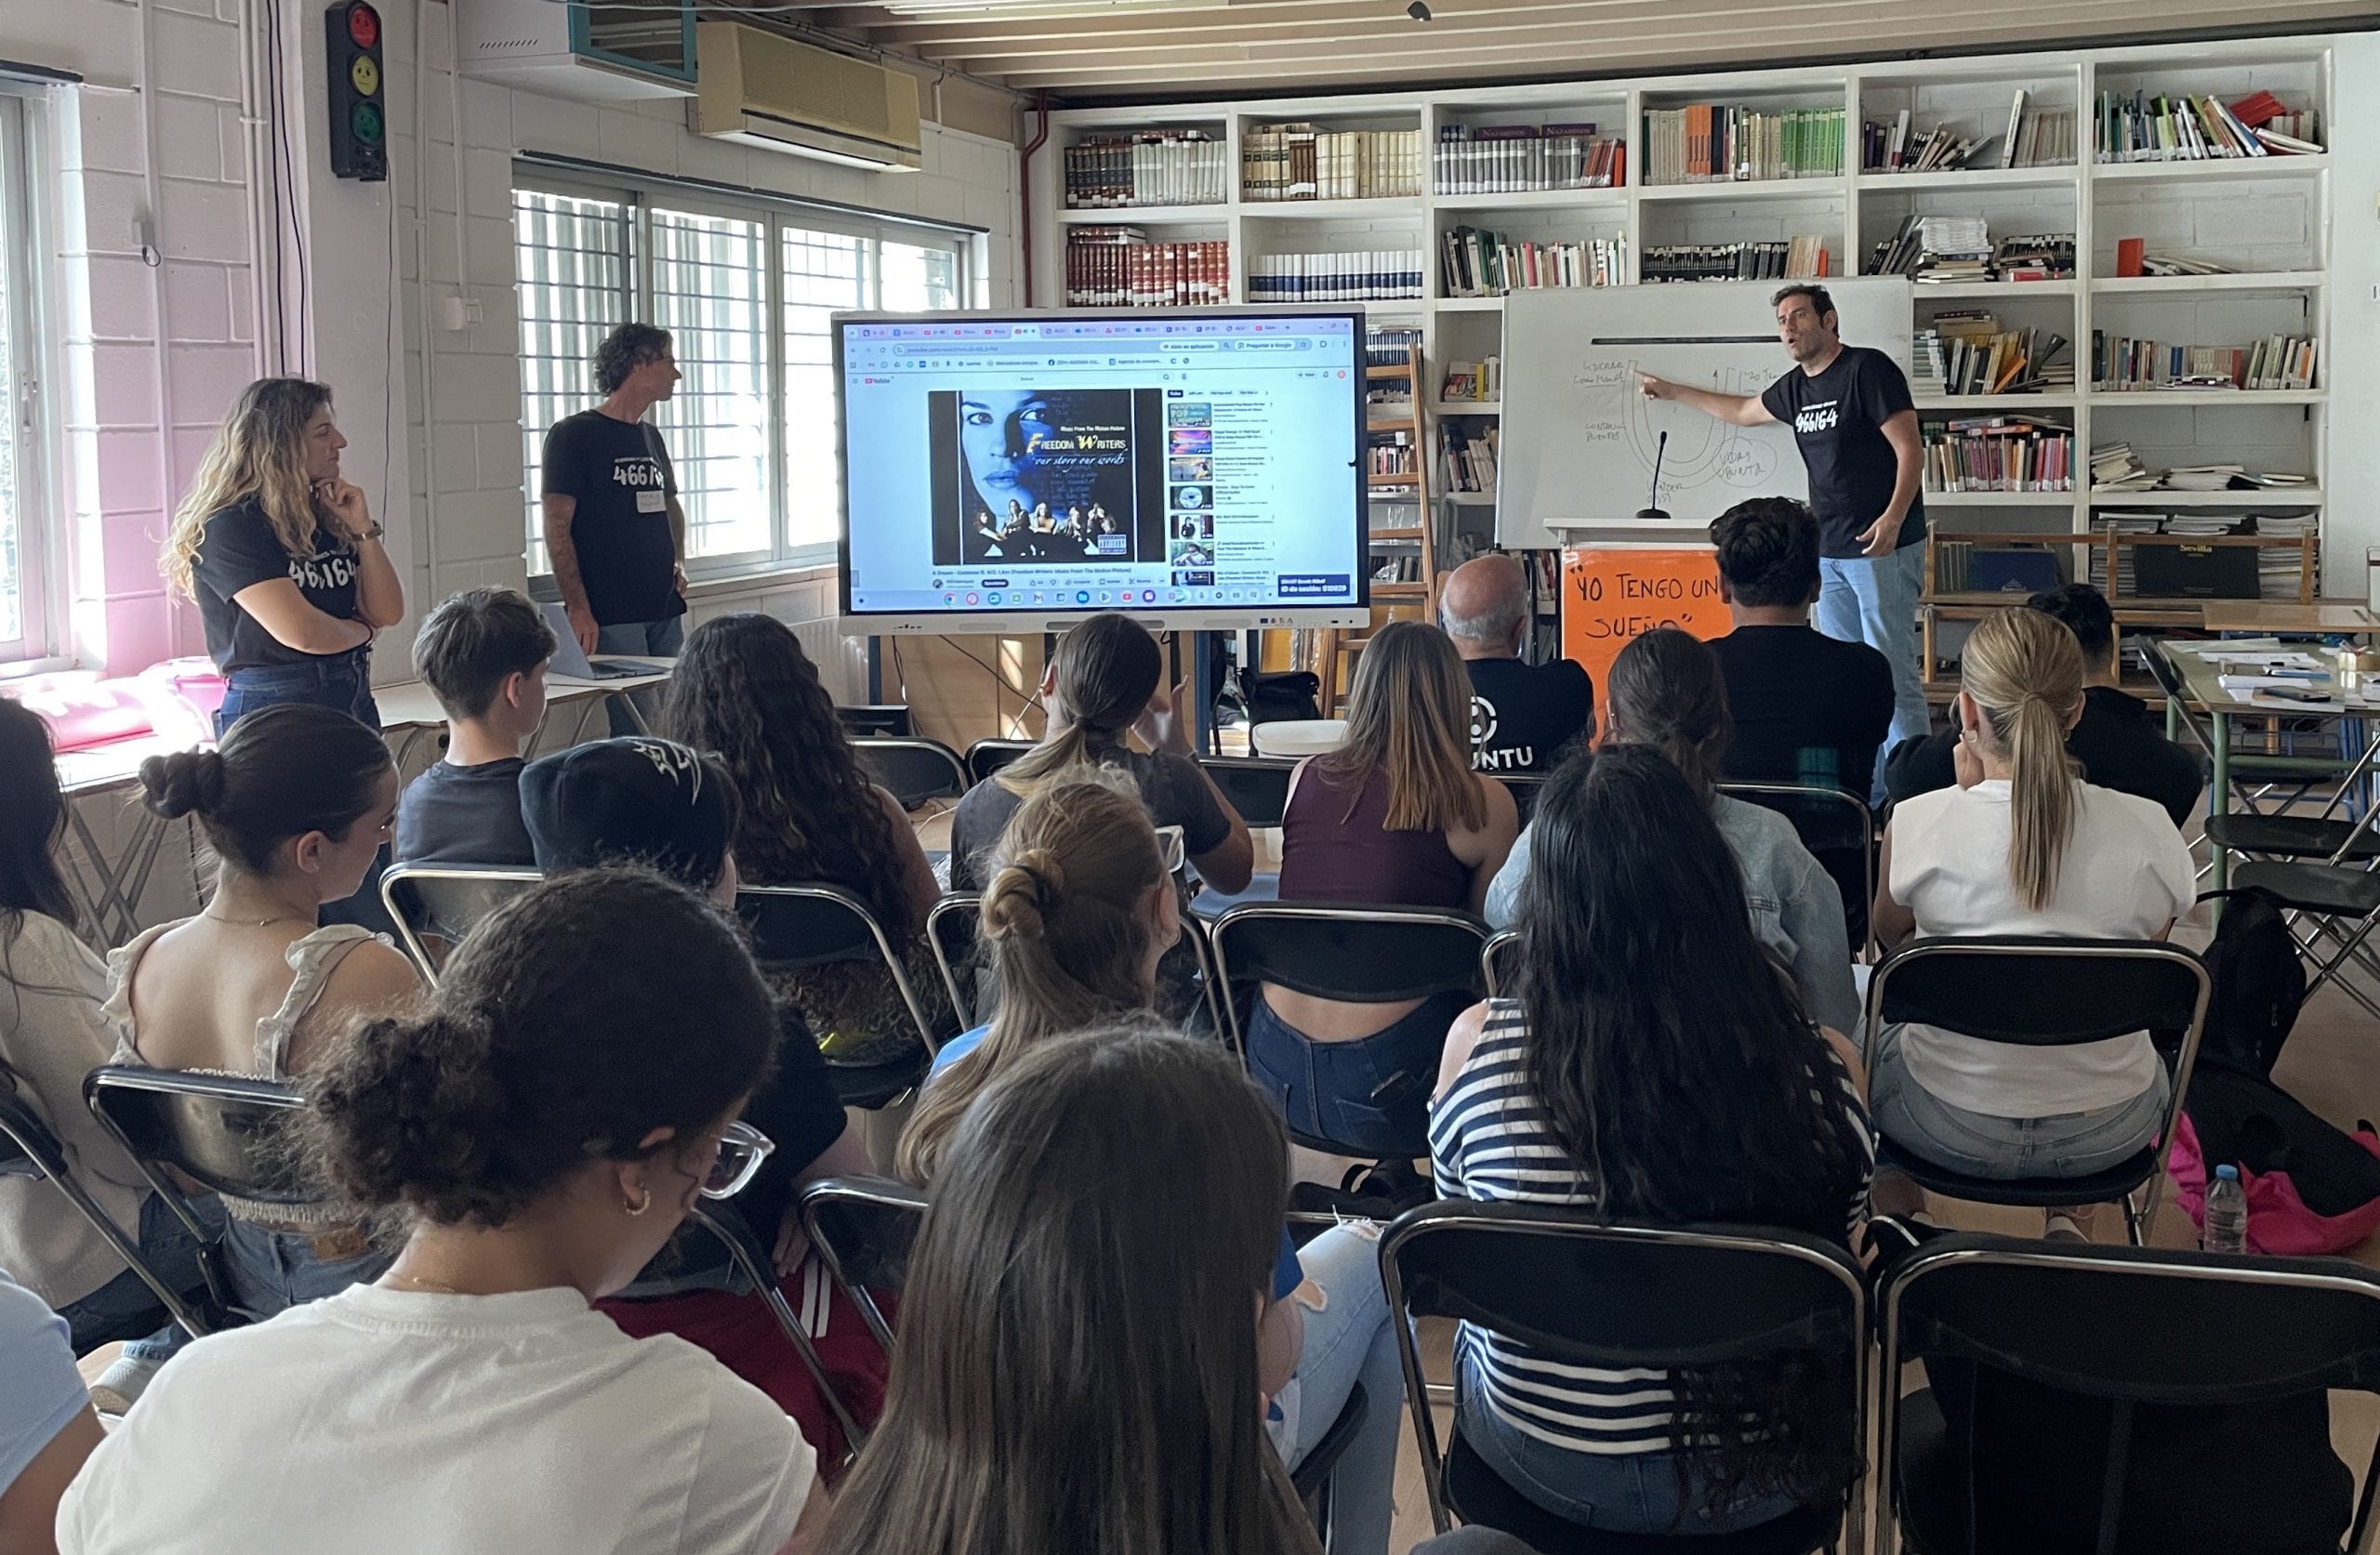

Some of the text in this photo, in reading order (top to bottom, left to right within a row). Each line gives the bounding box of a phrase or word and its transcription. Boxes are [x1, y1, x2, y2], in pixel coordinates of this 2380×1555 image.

[1616, 573, 1684, 600] TENGO
[1691, 574, 1719, 598] UN
[1471, 745, 1533, 771] UNTU
